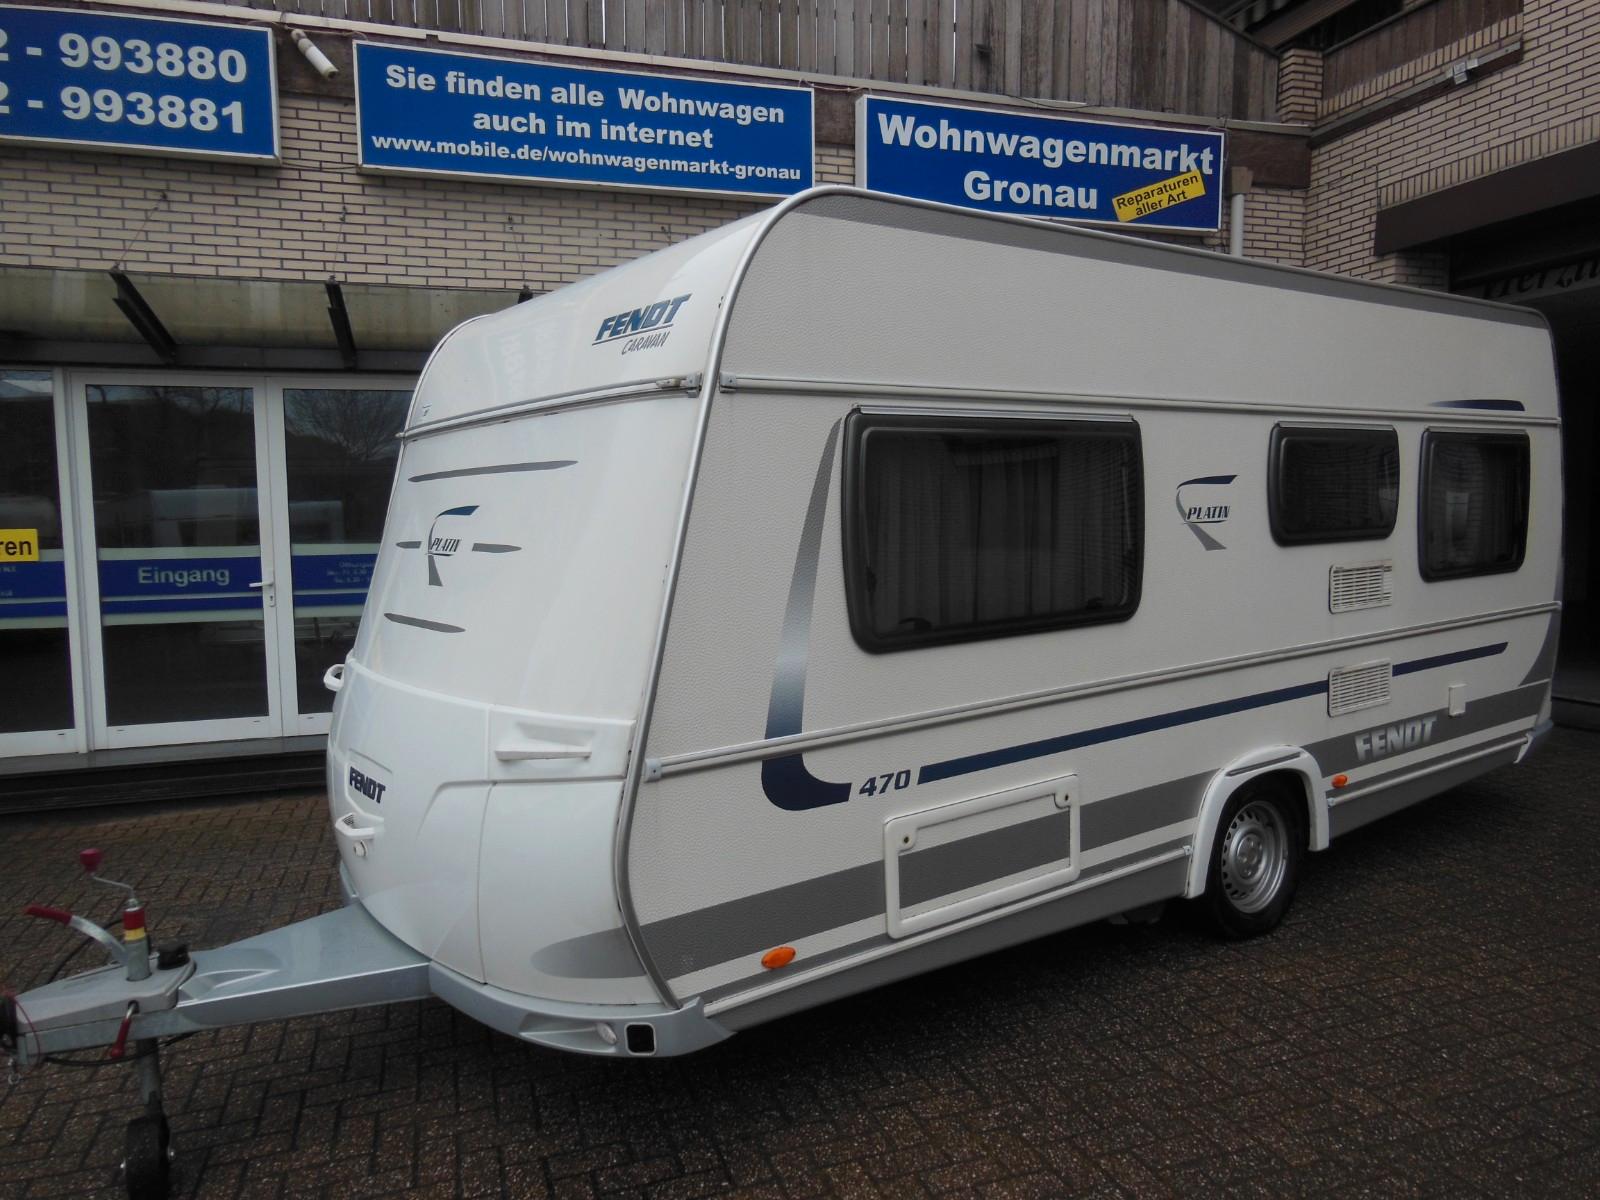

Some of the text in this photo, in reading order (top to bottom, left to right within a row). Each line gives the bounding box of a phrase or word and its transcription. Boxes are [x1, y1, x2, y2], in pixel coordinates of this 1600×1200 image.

[59, 32, 247, 83] 993880
[60, 86, 244, 134] 993881
[386, 64, 785, 124] Sie finden alle Wohnwagen
[473, 112, 713, 149] auch im internet
[877, 112, 1214, 175] Wohnwagenmarkt
[371, 135, 801, 180] www.mobile.de/wohnwagenmarkt-gronau
[963, 170, 1098, 210] Gronau
[1117, 175, 1198, 210] Reparaturen
[1135, 190, 1188, 216] aller Art
[595, 293, 692, 341] FENDT
[621, 331, 670, 356] CARAVAN
[1186, 505, 1230, 520] PLATIN
[430, 537, 461, 553] PLATIN
[137, 566, 230, 587] Eingang
[1354, 714, 1437, 761] FENDT
[349, 766, 386, 804] FENDT
[858, 769, 911, 797] 470
